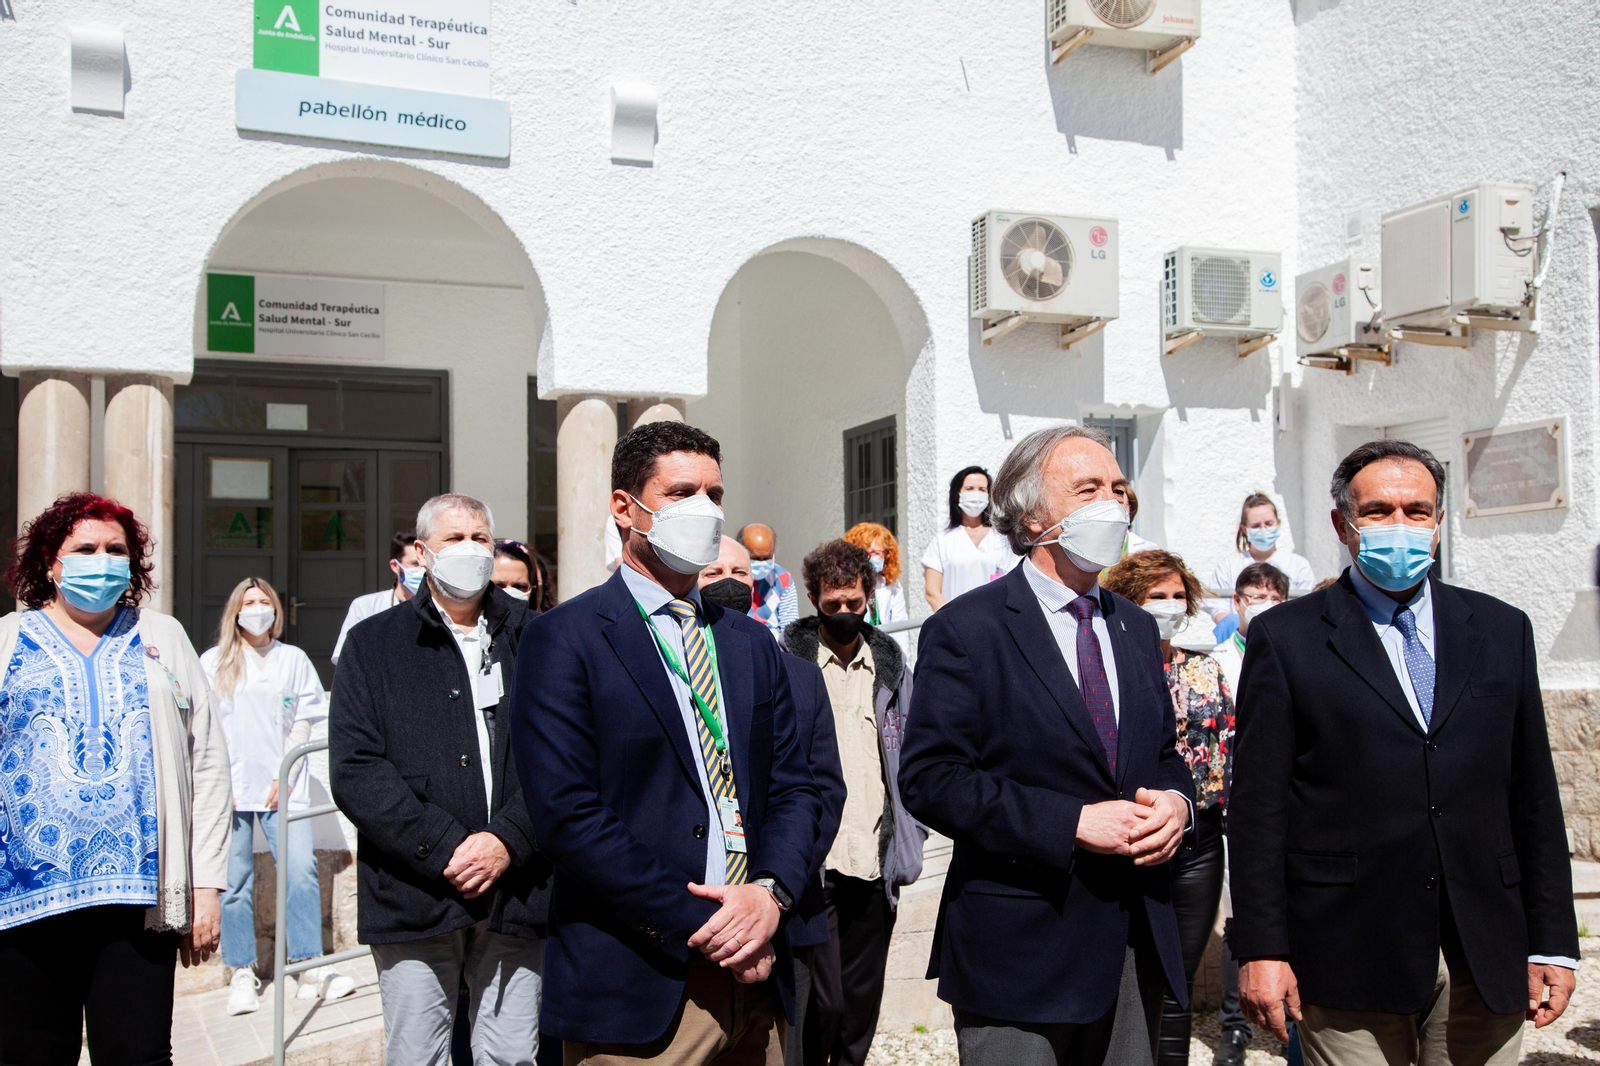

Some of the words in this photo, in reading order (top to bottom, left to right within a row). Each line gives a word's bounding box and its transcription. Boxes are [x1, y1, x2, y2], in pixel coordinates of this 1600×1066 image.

[325, 5, 405, 25] Comunidad
[409, 14, 488, 35] Terapéutica
[285, 32, 316, 42] Andalucía
[325, 25, 365, 40] Salud
[369, 32, 416, 46] Mental
[428, 37, 450, 50] Sur
[325, 42, 360, 54] Hospital
[362, 46, 414, 60] Universitario
[416, 52, 444, 64] Clínico
[446, 56, 461, 65] San
[463, 58, 489, 68] Cecilio
[299, 100, 387, 122] pabellón
[398, 112, 467, 131] médico
[1091, 249, 1106, 260] LG
[259, 299, 317, 311] Comunidad
[321, 303, 380, 314] Terapéutica
[1335, 297, 1346, 308] LG
[259, 314, 288, 323] Salud
[291, 316, 326, 325] Mental
[334, 318, 352, 327] Sur
